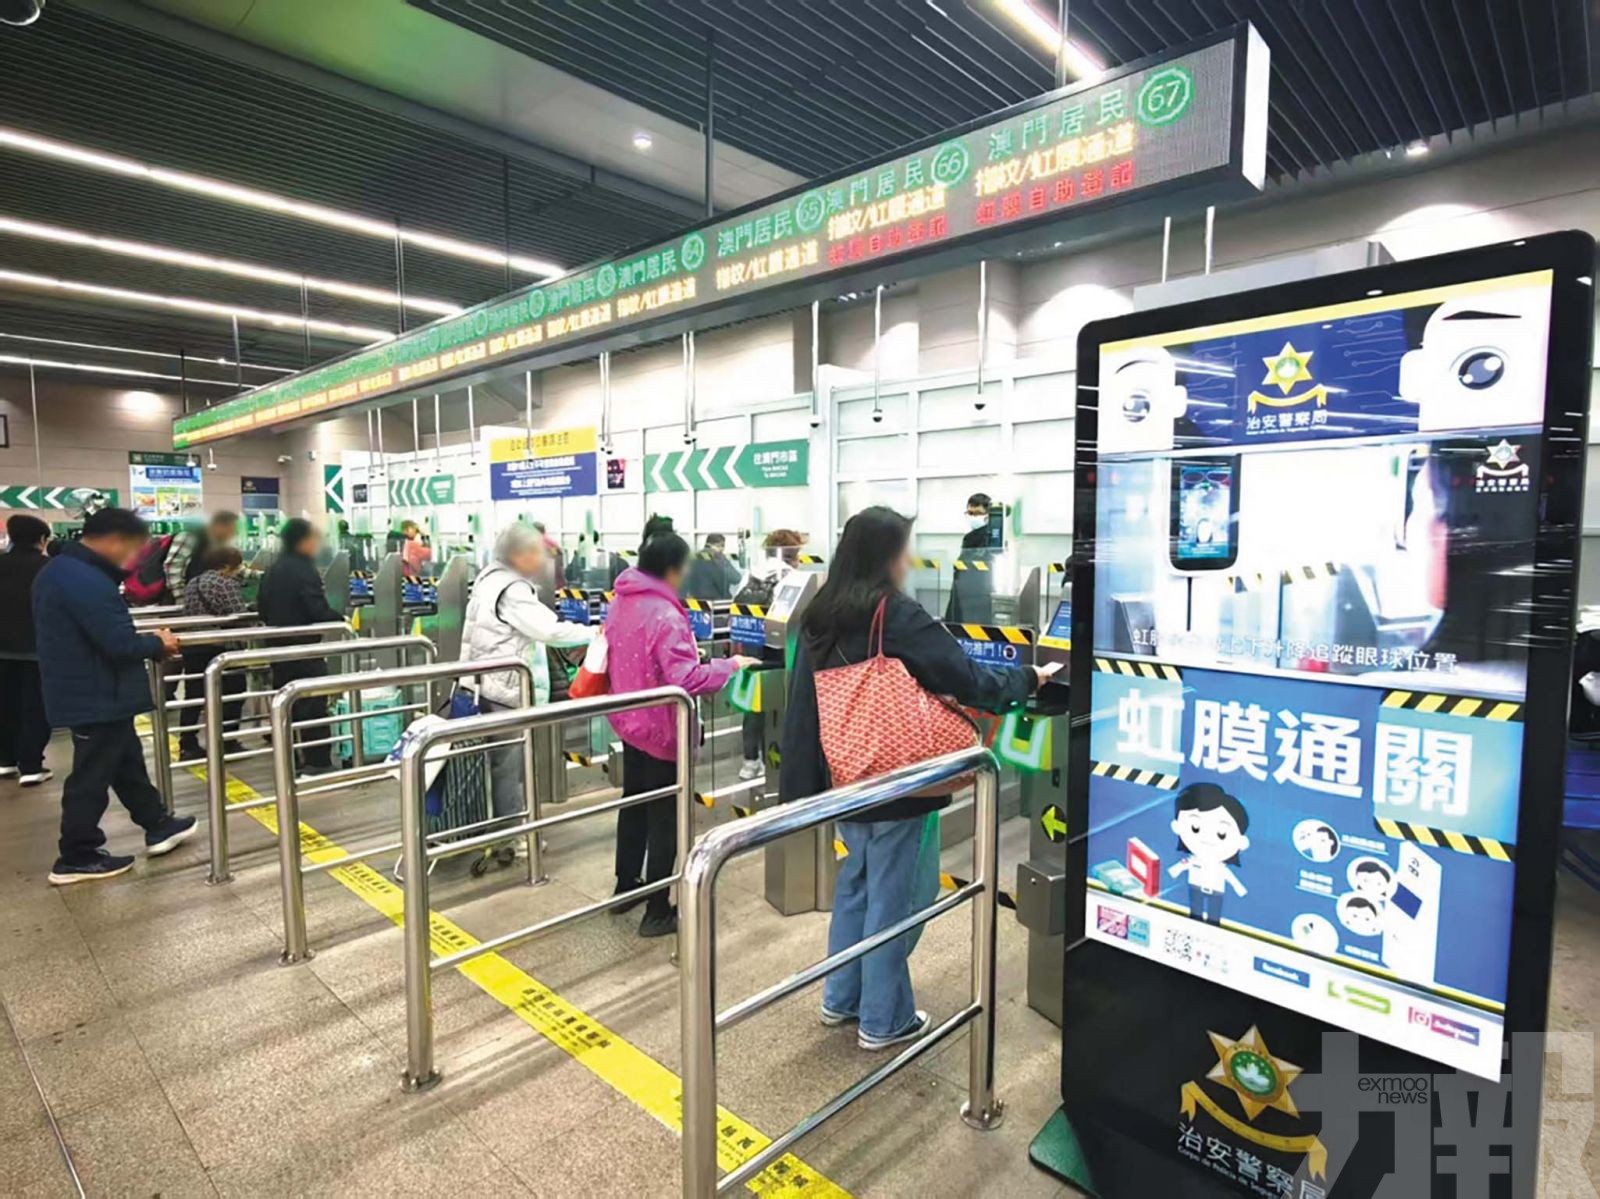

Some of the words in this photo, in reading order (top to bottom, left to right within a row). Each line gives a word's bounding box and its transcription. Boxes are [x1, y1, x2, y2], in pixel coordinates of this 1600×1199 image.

[988, 89, 1126, 161] 澳門居民
[1147, 79, 1181, 113] 67
[826, 159, 924, 213] 澳門居民
[937, 151, 962, 177] 66
[717, 211, 791, 257] 澳門居民
[618, 249, 677, 288] 澳門居民
[1246, 410, 1328, 430] 治安警察局
[1115, 688, 1473, 817] 虹膜通關
